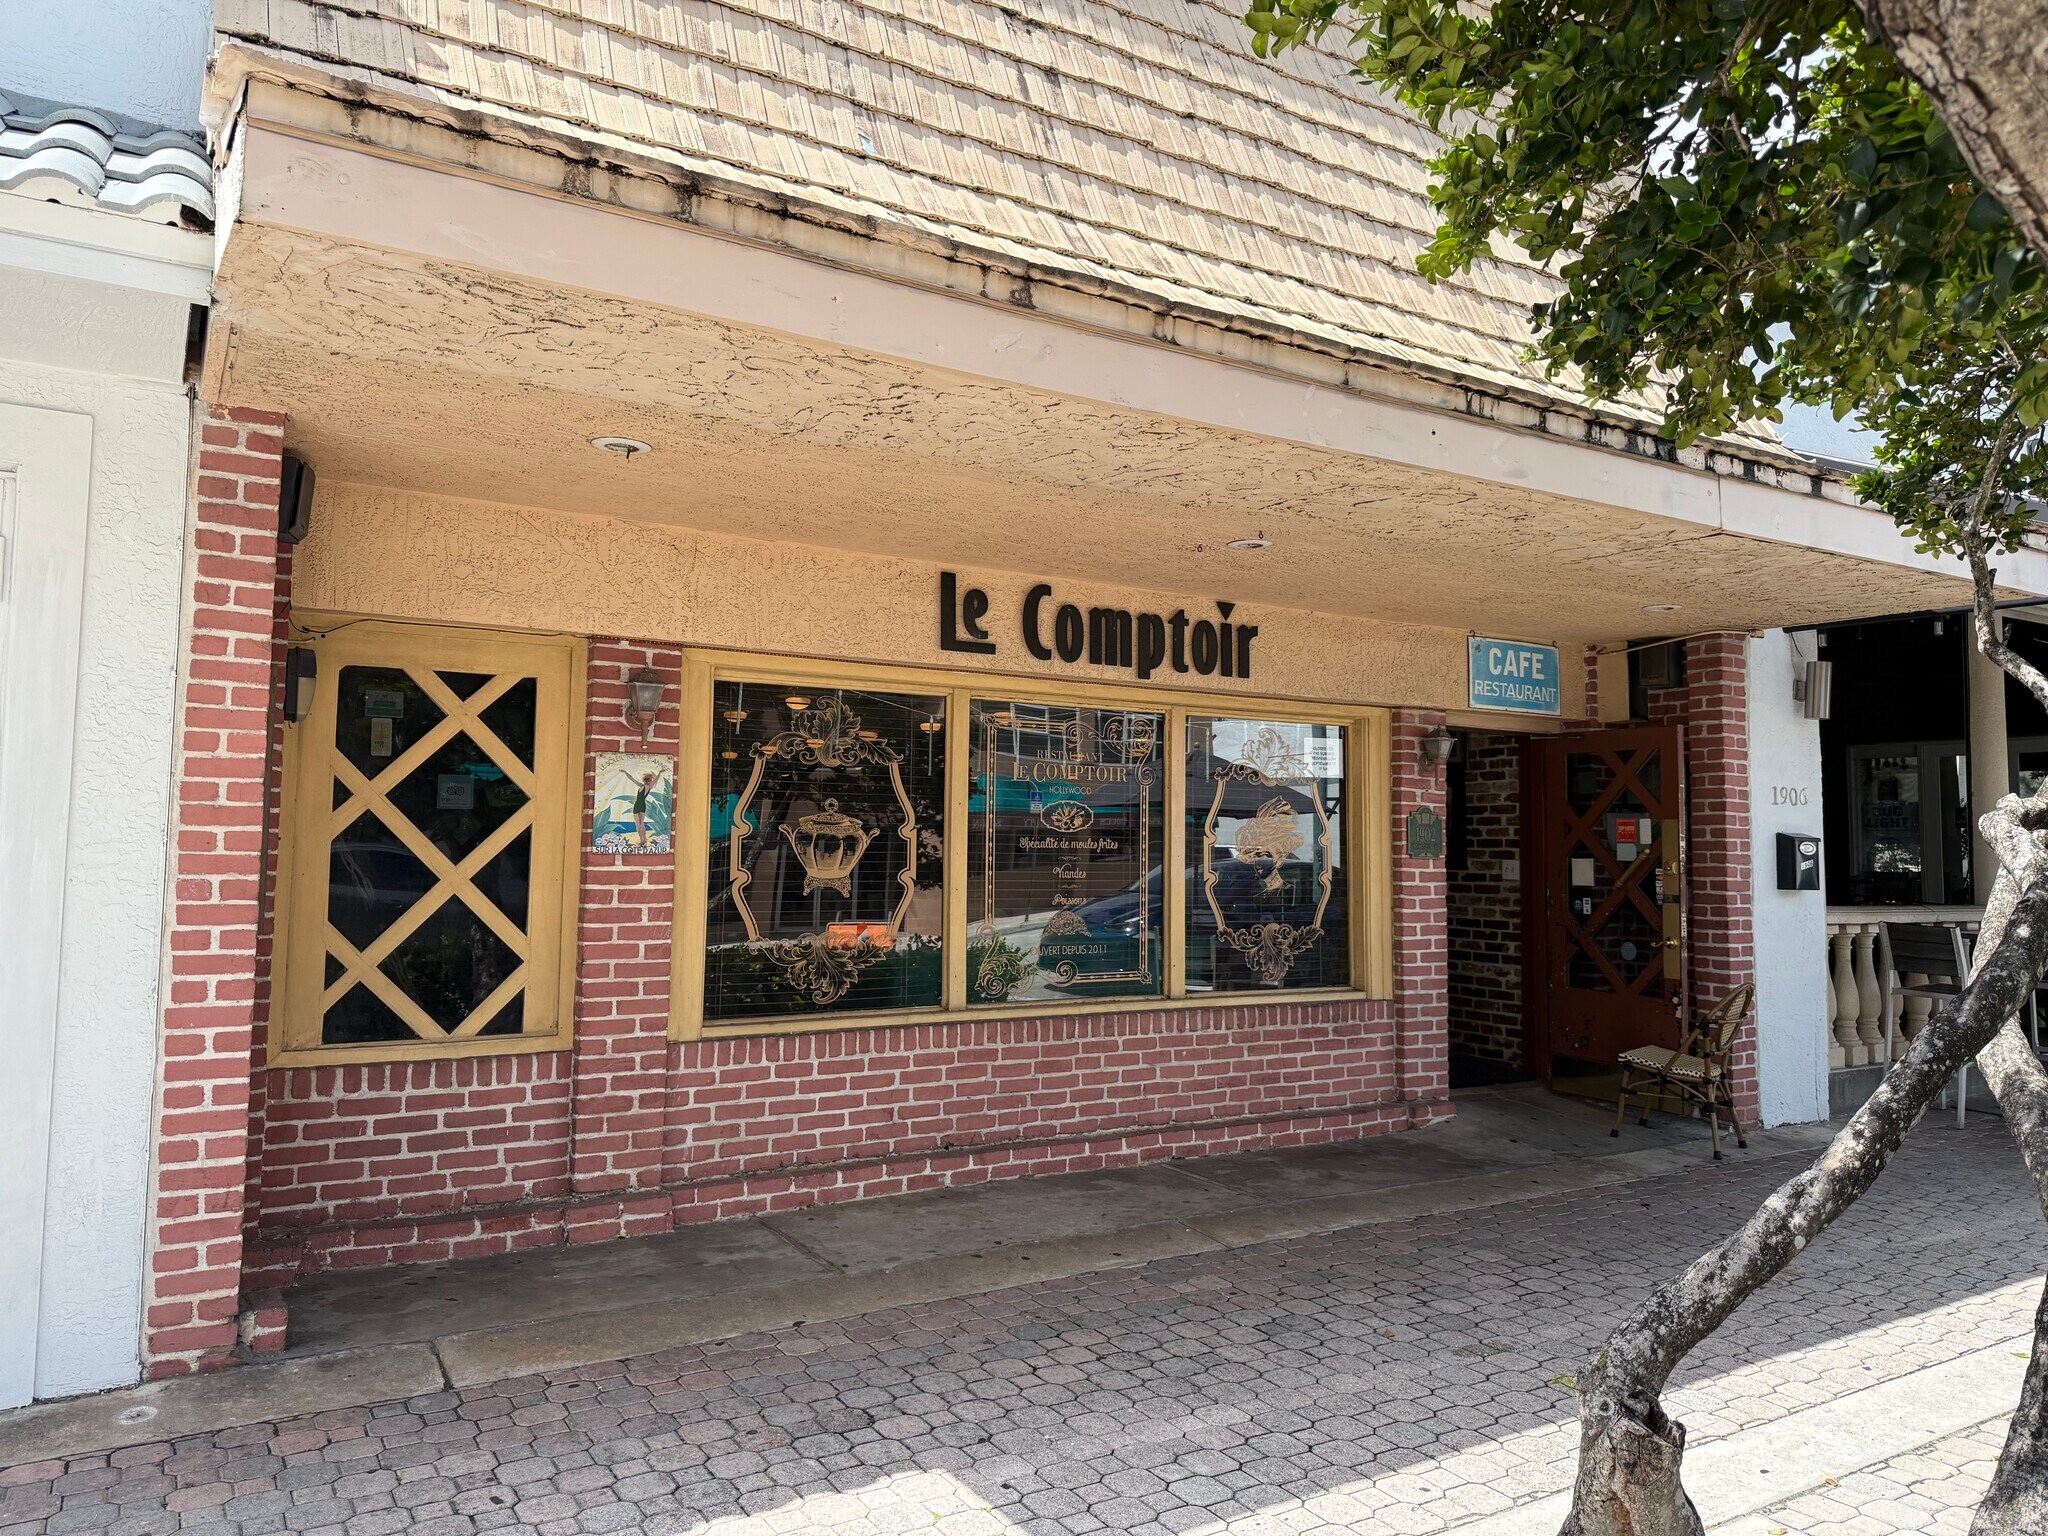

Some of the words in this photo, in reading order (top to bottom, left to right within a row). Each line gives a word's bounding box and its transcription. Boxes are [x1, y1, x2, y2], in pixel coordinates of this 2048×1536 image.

[940, 571, 996, 655] Le
[1023, 584, 1258, 679] Comptoir
[1489, 647, 1545, 680] CAFE
[1474, 680, 1557, 703] RESTAURANT
[1037, 749, 1105, 762] RESTAURANT
[1011, 761, 1030, 781] LE
[1032, 762, 1127, 782] COMPTOIR
[1049, 786, 1092, 795] HOLLYWOOD
[1770, 786, 1809, 806] 1906
[1866, 817, 1910, 828] LIGHT
[1416, 827, 1436, 842] 1902
[595, 846, 610, 854] SUR
[611, 846, 621, 854] LA
[1060, 837, 1071, 849] de
[1071, 838, 1097, 849] moules
[1096, 838, 1119, 853] frites
[1052, 863, 1087, 879] Viandes
[1052, 894, 1087, 906] Poissons
[1030, 945, 1061, 956] OUVERT
[1062, 945, 1087, 955] DEPUIS
[1088, 944, 1107, 954] 2011
